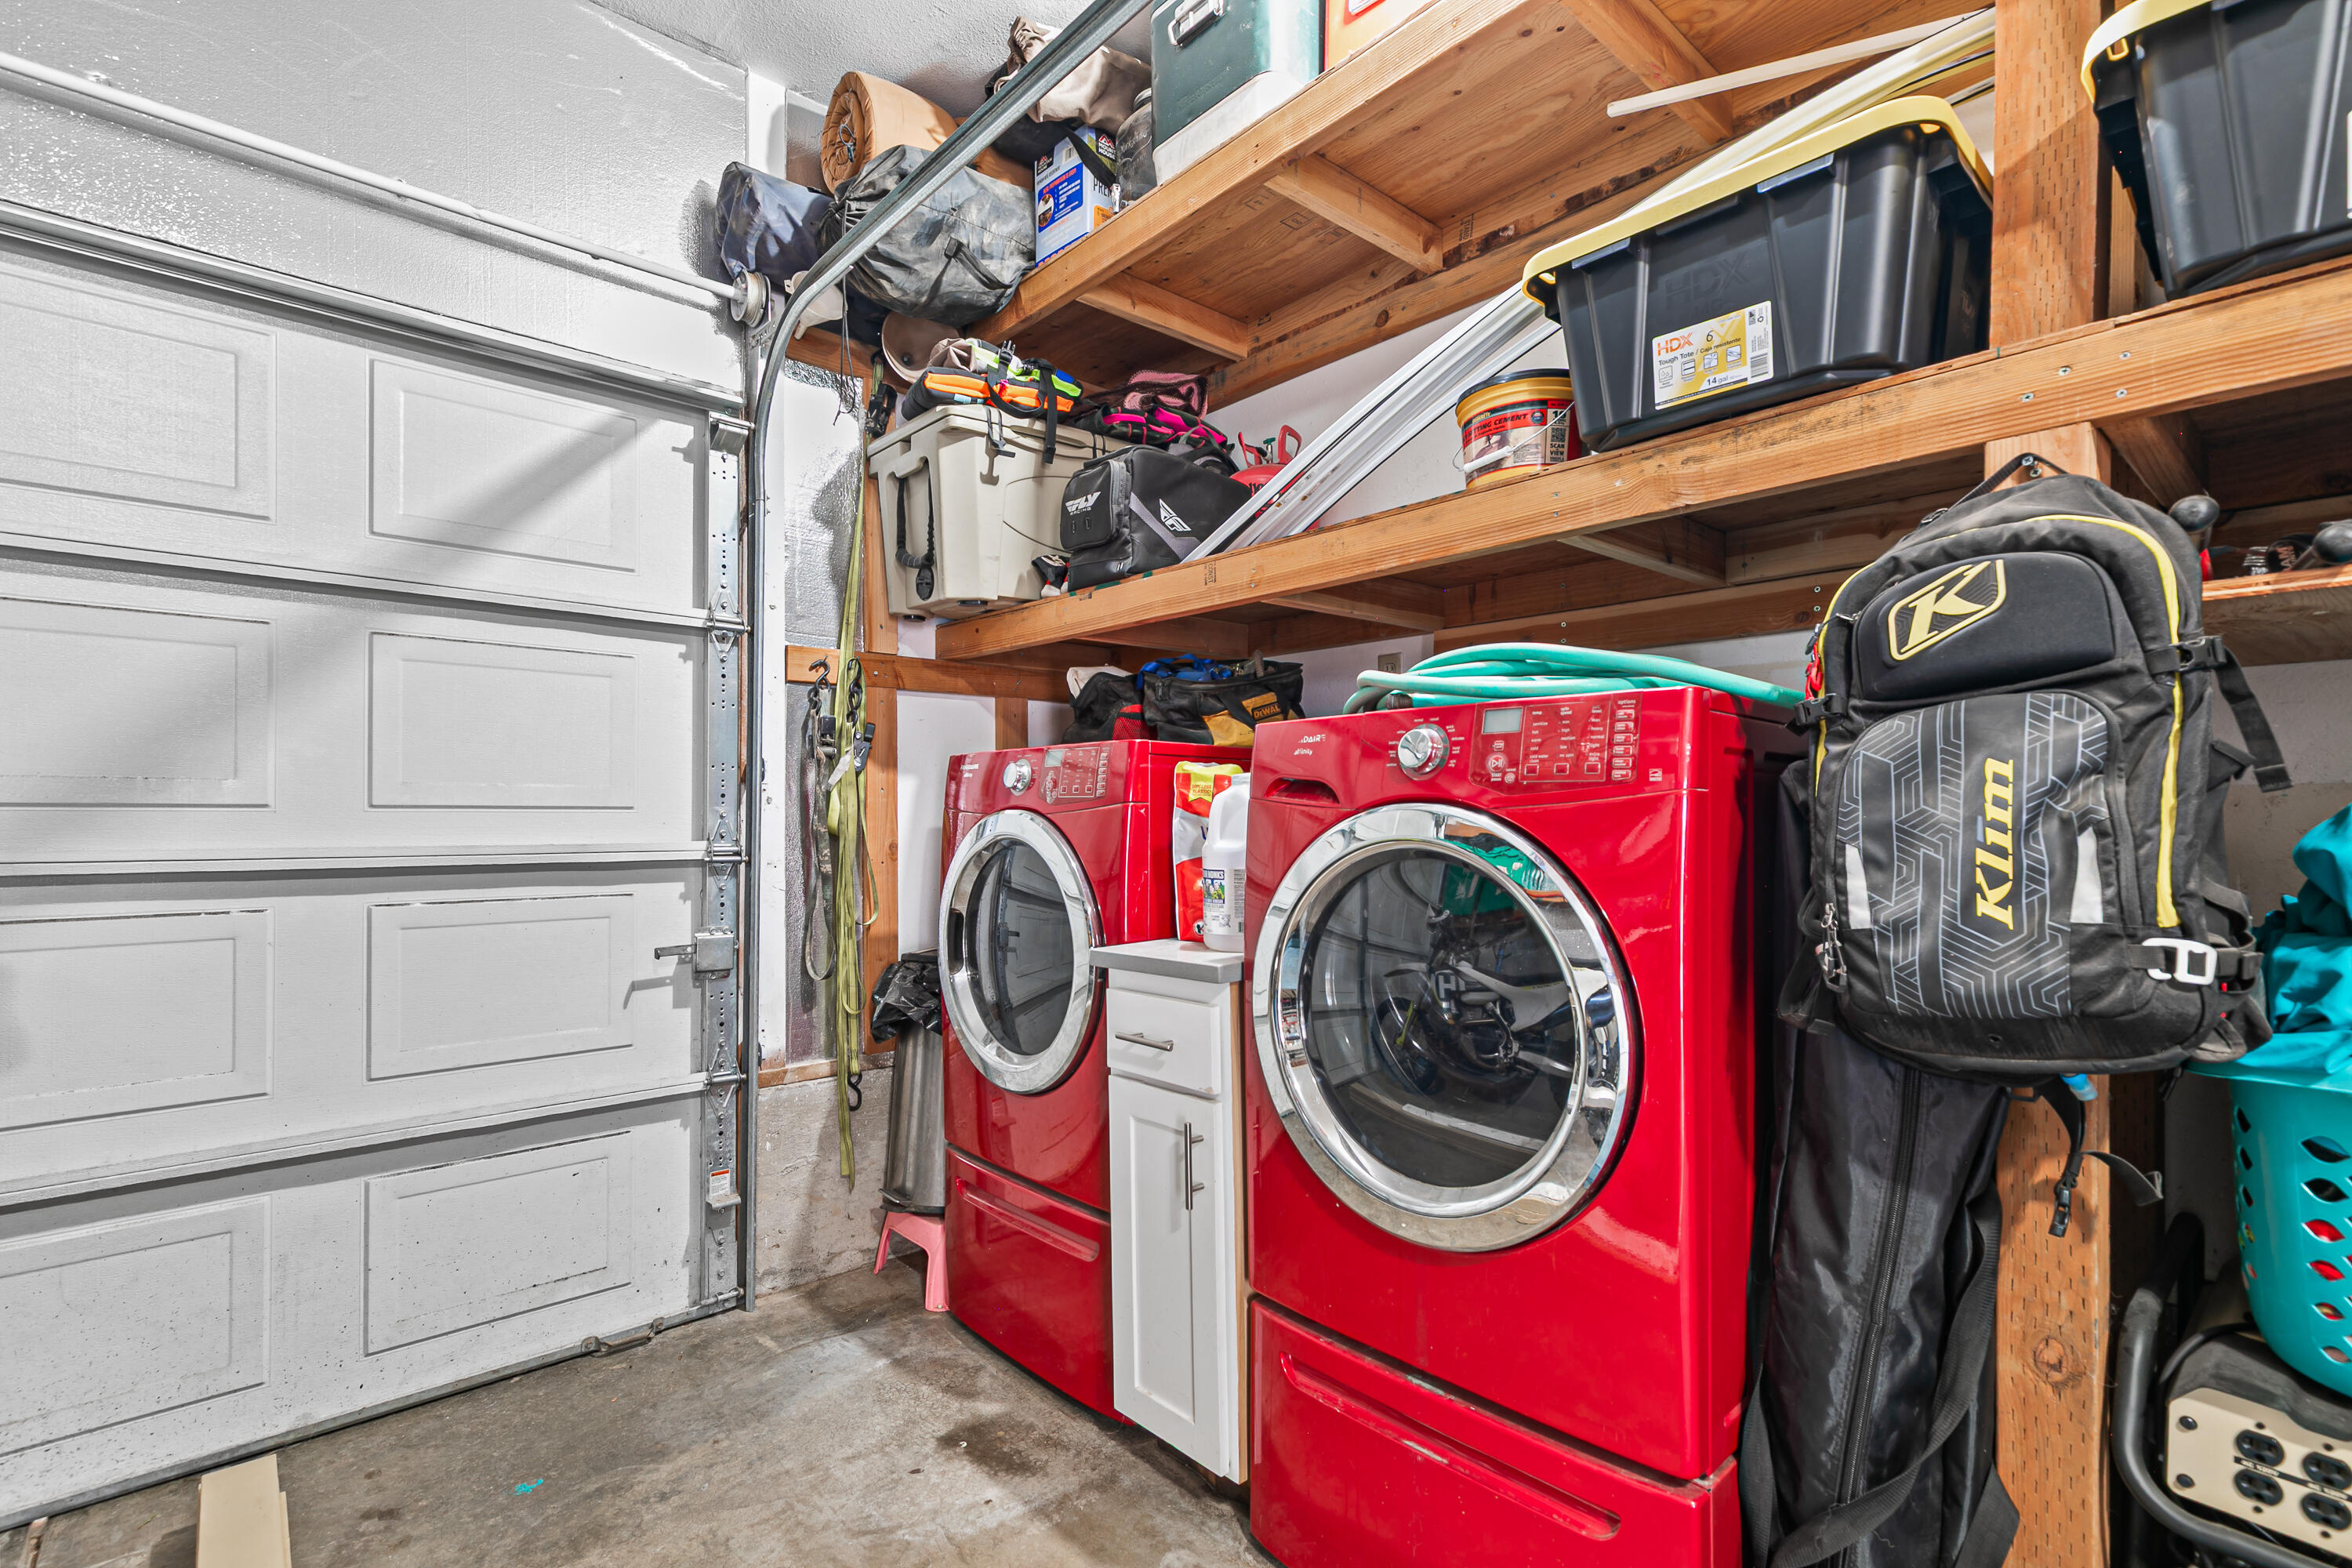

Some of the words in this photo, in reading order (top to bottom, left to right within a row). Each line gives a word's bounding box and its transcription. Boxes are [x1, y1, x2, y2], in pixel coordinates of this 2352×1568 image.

[1098, 148, 1116, 160] HOUSE
[1657, 332, 1693, 357] HDX
[1658, 356, 1679, 366] Tough
[1680, 350, 1694, 360] Tote
[1713, 337, 1741, 349] resistente
[1707, 377, 1717, 386] 14
[1718, 376, 1729, 385] gal
[1494, 413, 1528, 425] CEMENT
[1065, 492, 1102, 513] FLY
[1069, 506, 1092, 516] RACING
[1254, 704, 1280, 718] DEWAL
